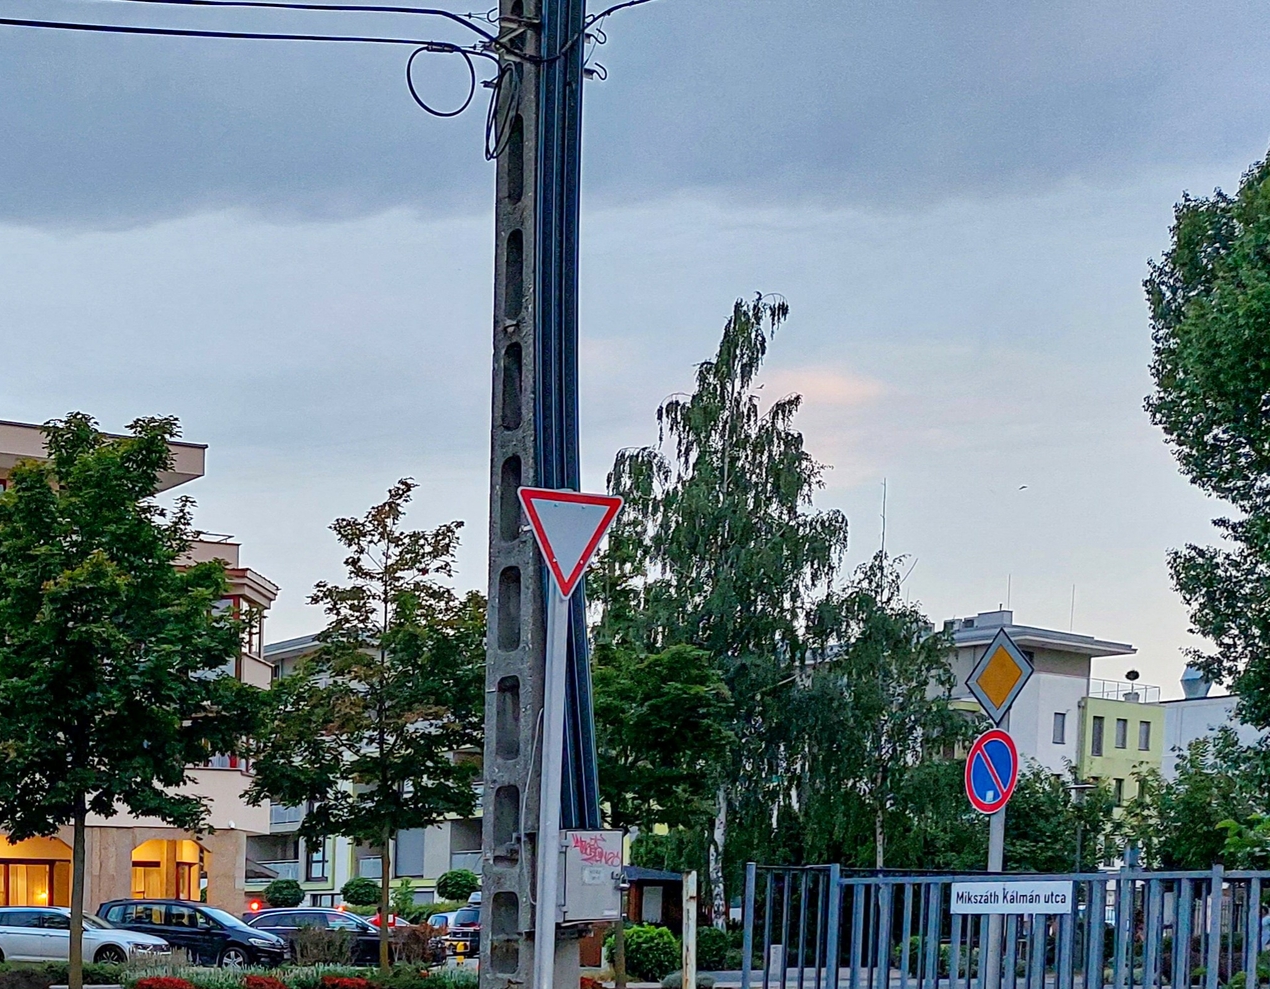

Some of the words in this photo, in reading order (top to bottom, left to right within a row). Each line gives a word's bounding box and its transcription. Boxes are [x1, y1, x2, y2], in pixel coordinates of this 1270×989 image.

[955, 889, 999, 904] Mikszáth
[1002, 888, 1041, 904] Kálmán
[1043, 891, 1067, 904] utca
